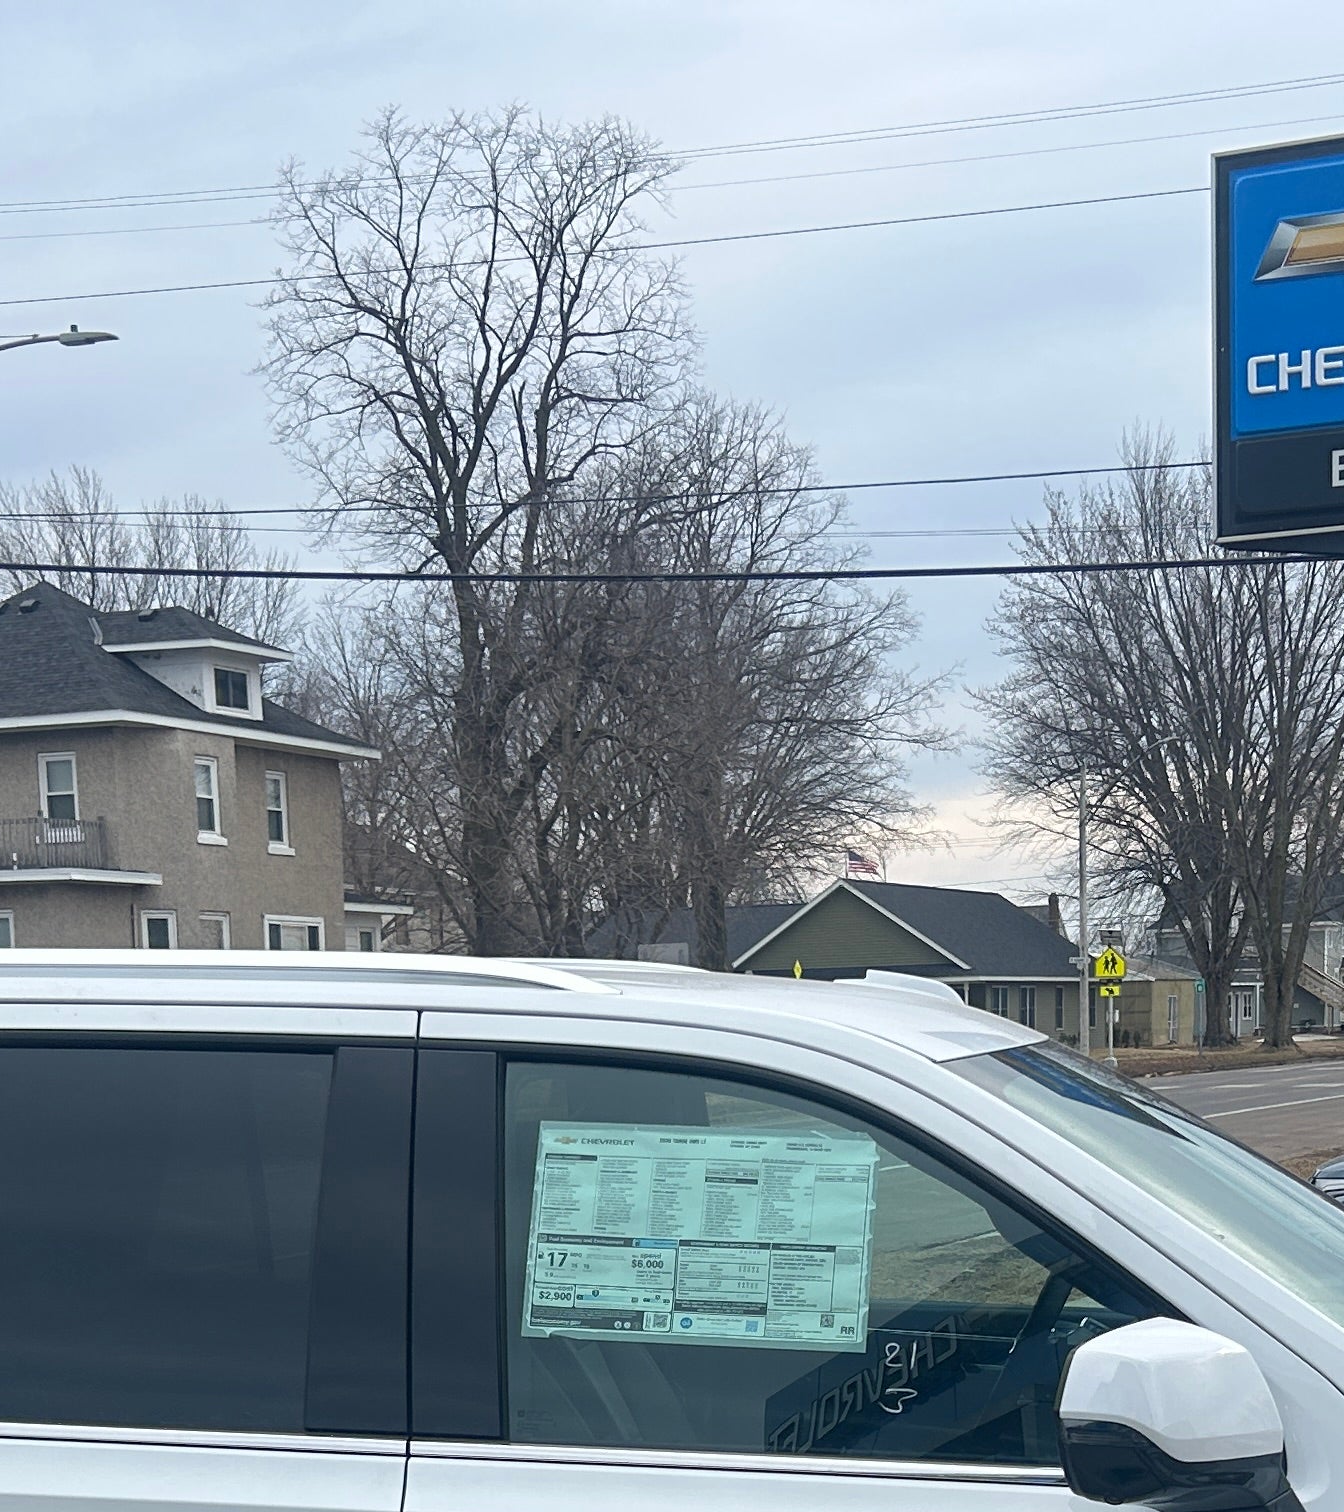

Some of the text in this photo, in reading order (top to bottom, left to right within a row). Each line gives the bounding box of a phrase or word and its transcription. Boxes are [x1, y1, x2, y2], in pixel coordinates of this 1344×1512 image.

[580, 1137, 635, 1146] CHEVROLET
[547, 1252, 568, 1267] 17
[631, 1259, 664, 1270] $6,000
[539, 1290, 572, 1301] $2,900
[840, 1326, 855, 1335] RR
